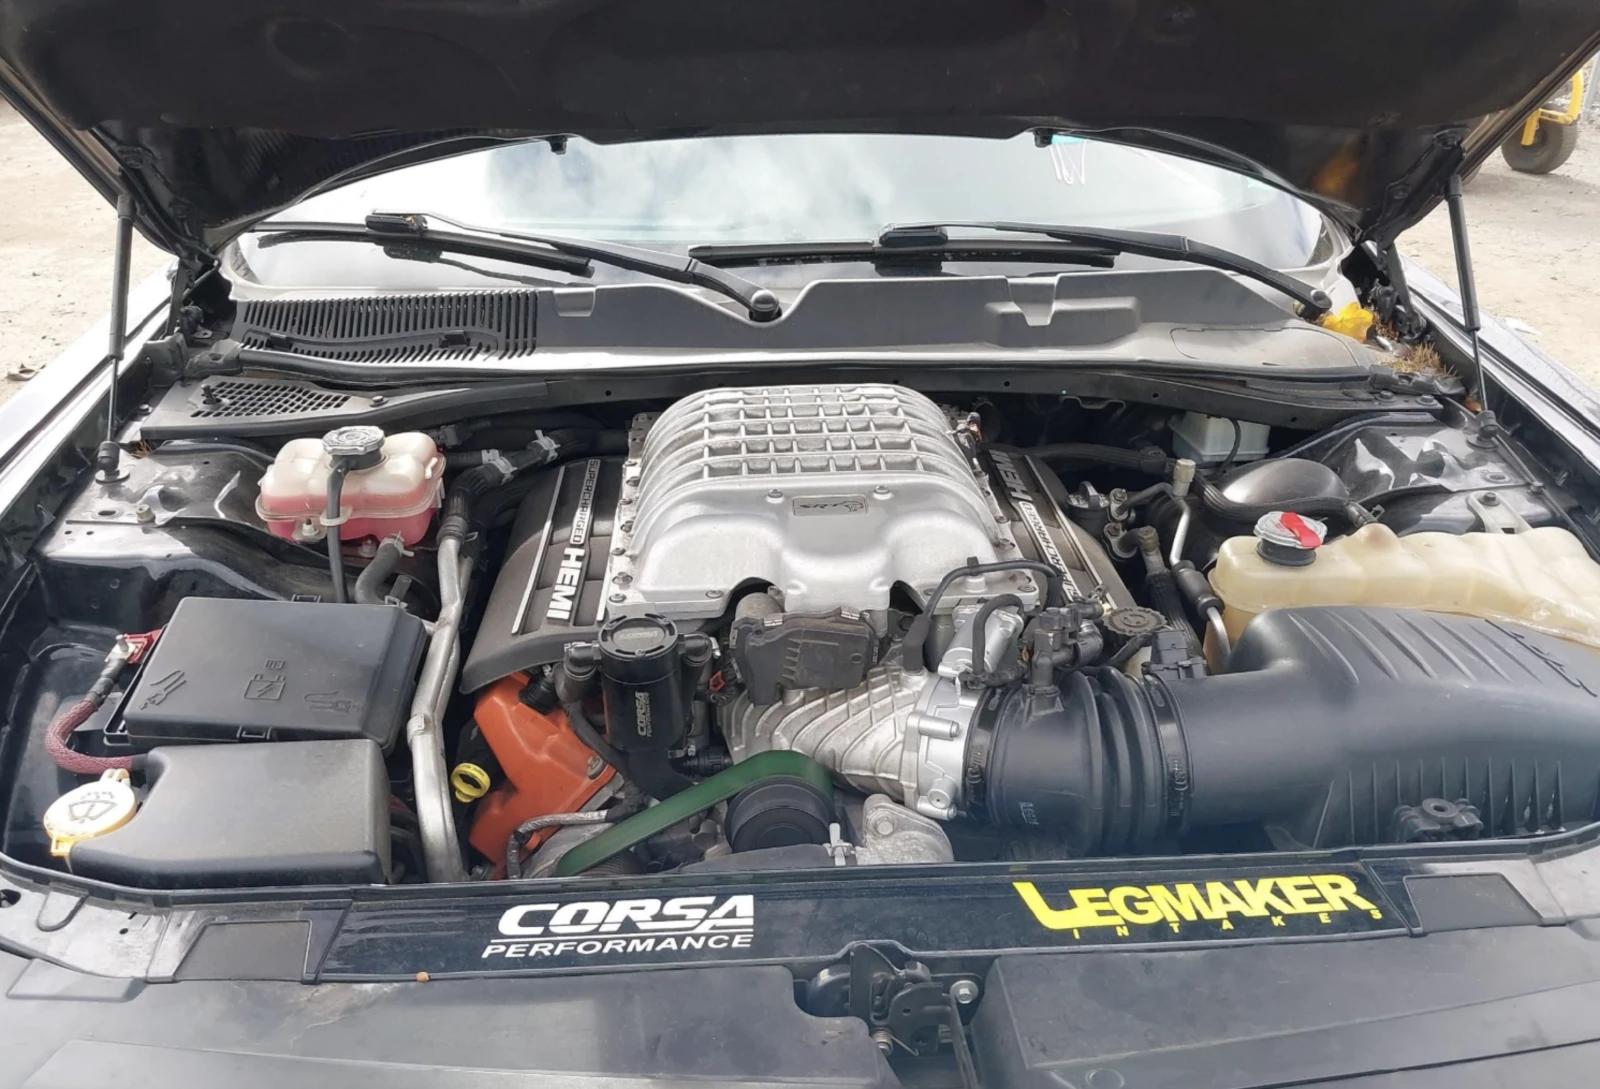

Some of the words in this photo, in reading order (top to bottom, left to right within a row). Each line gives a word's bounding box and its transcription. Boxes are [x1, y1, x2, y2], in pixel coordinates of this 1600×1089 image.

[988, 449, 1034, 501] HEMI
[571, 460, 600, 544] SUPERCHARGED
[546, 547, 586, 620] HEMI
[635, 691, 647, 736] CORSA
[498, 895, 754, 936] CORSA
[1012, 874, 1377, 930] LEGMAKER
[1073, 909, 1382, 939] INTAKES
[481, 934, 754, 958] PERFORMANCE
